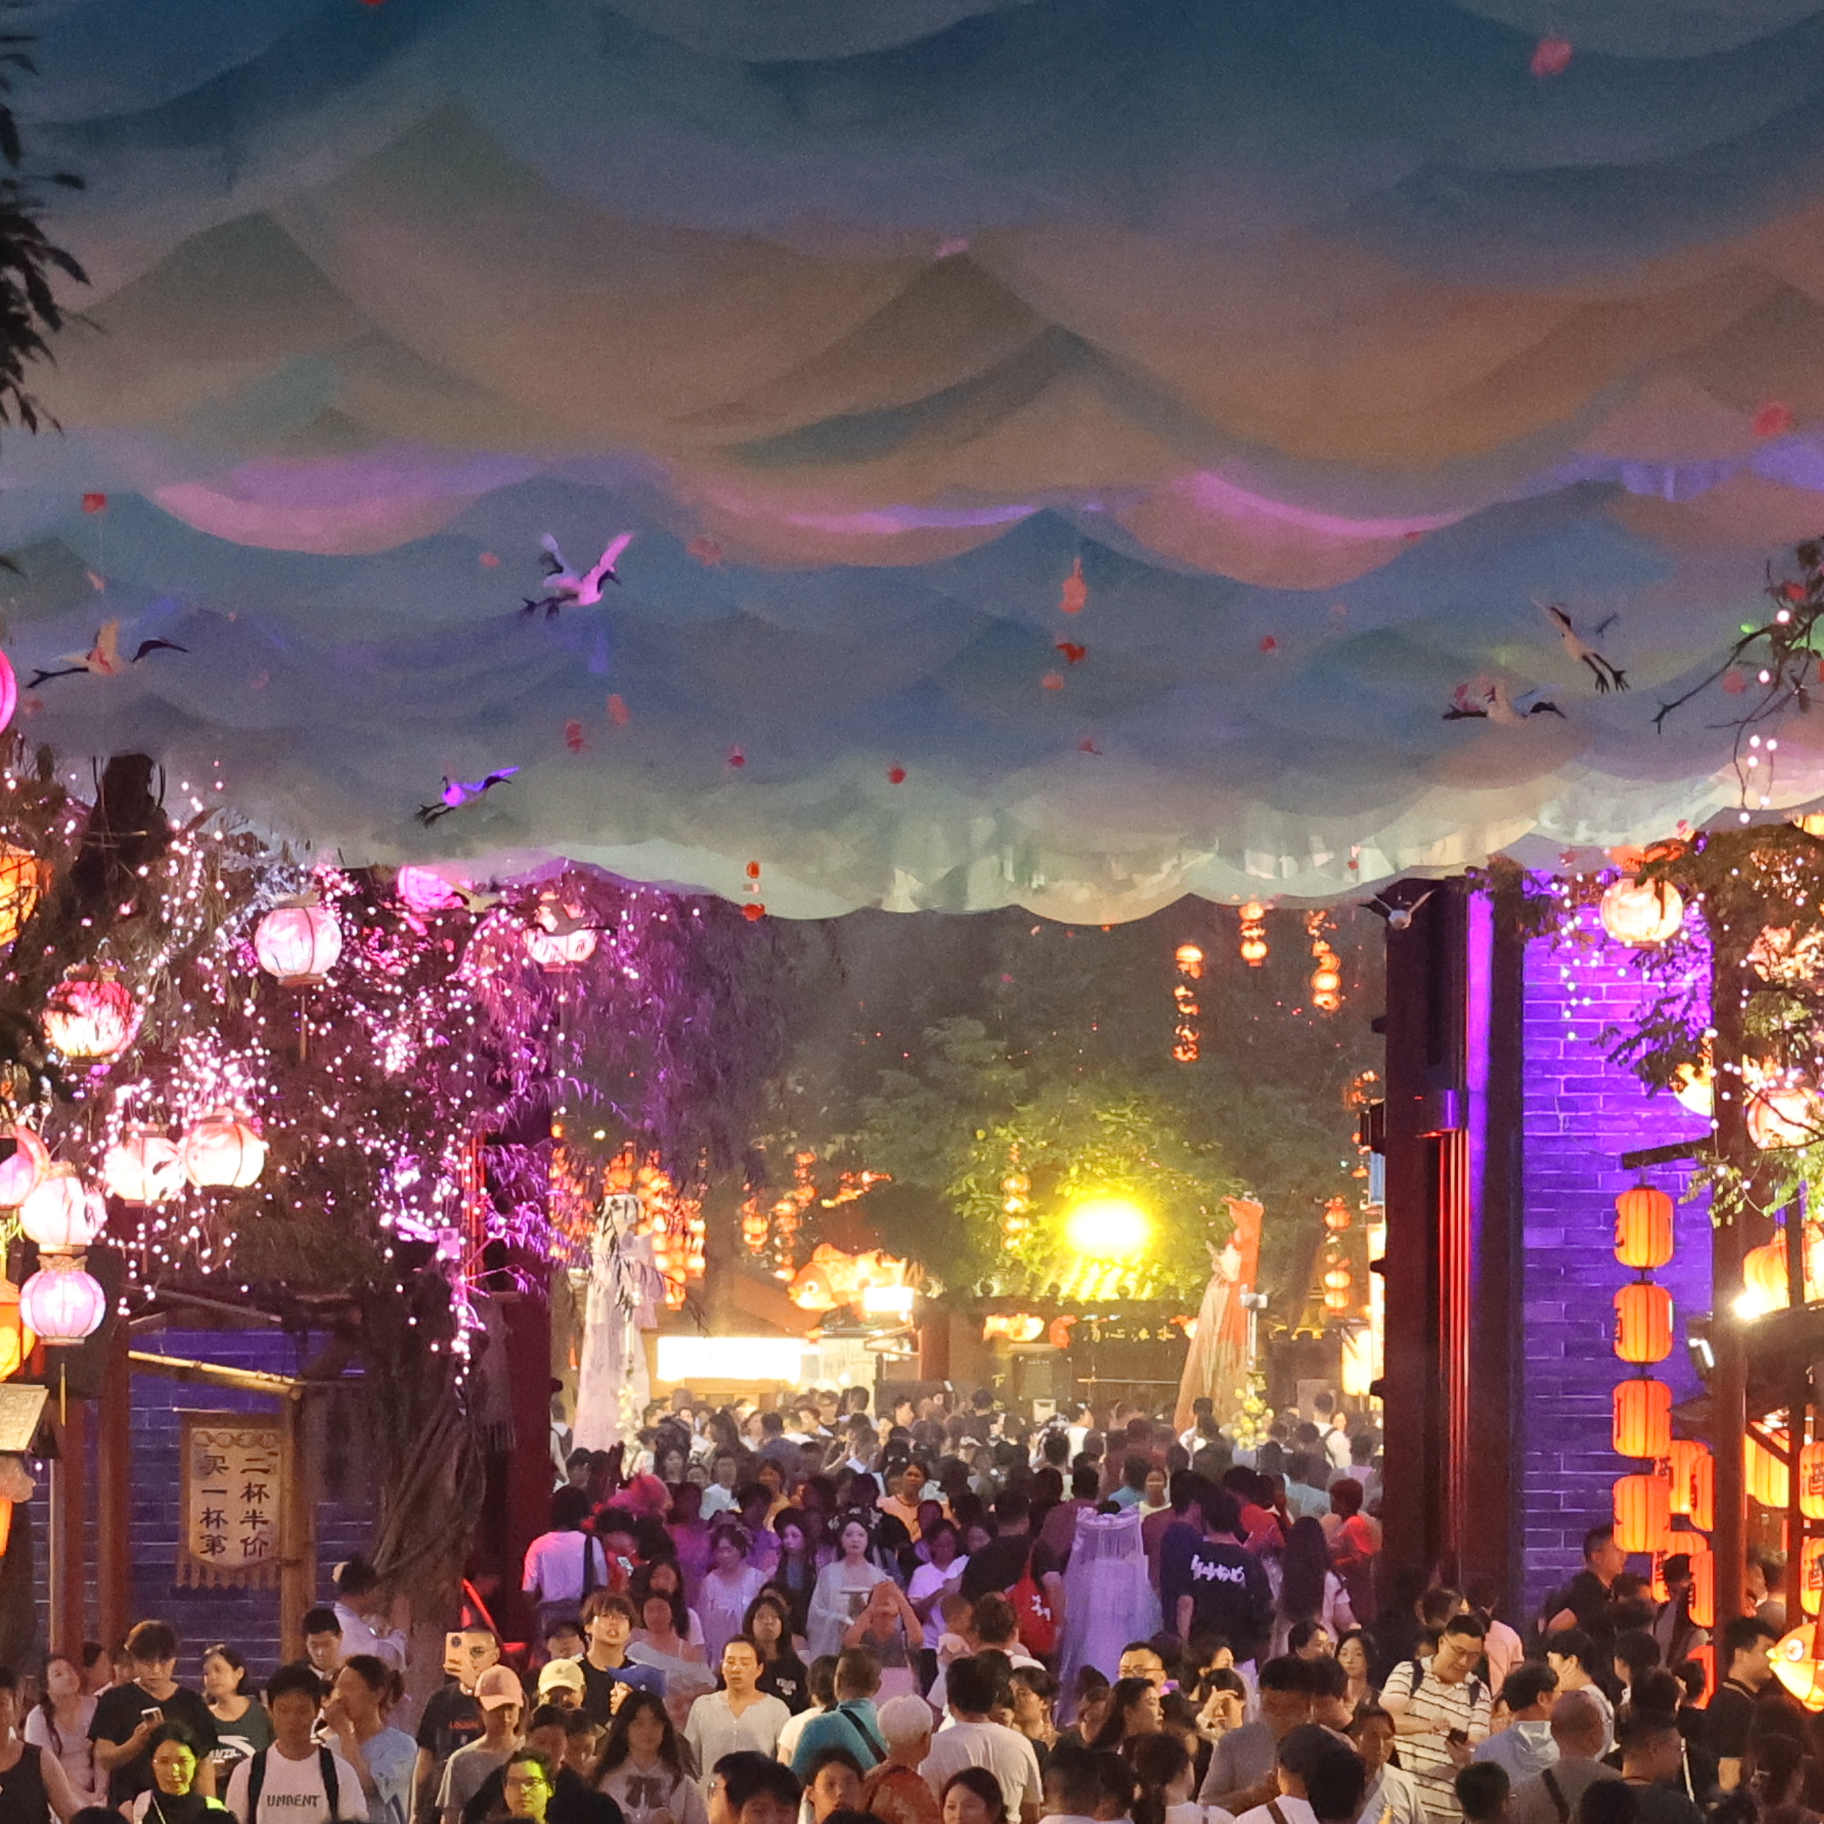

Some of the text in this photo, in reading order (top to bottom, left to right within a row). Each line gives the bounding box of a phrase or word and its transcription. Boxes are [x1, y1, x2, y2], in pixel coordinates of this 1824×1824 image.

[200, 1454, 229, 1556] 买一杯第
[239, 1456, 272, 1558] 二杯半价
